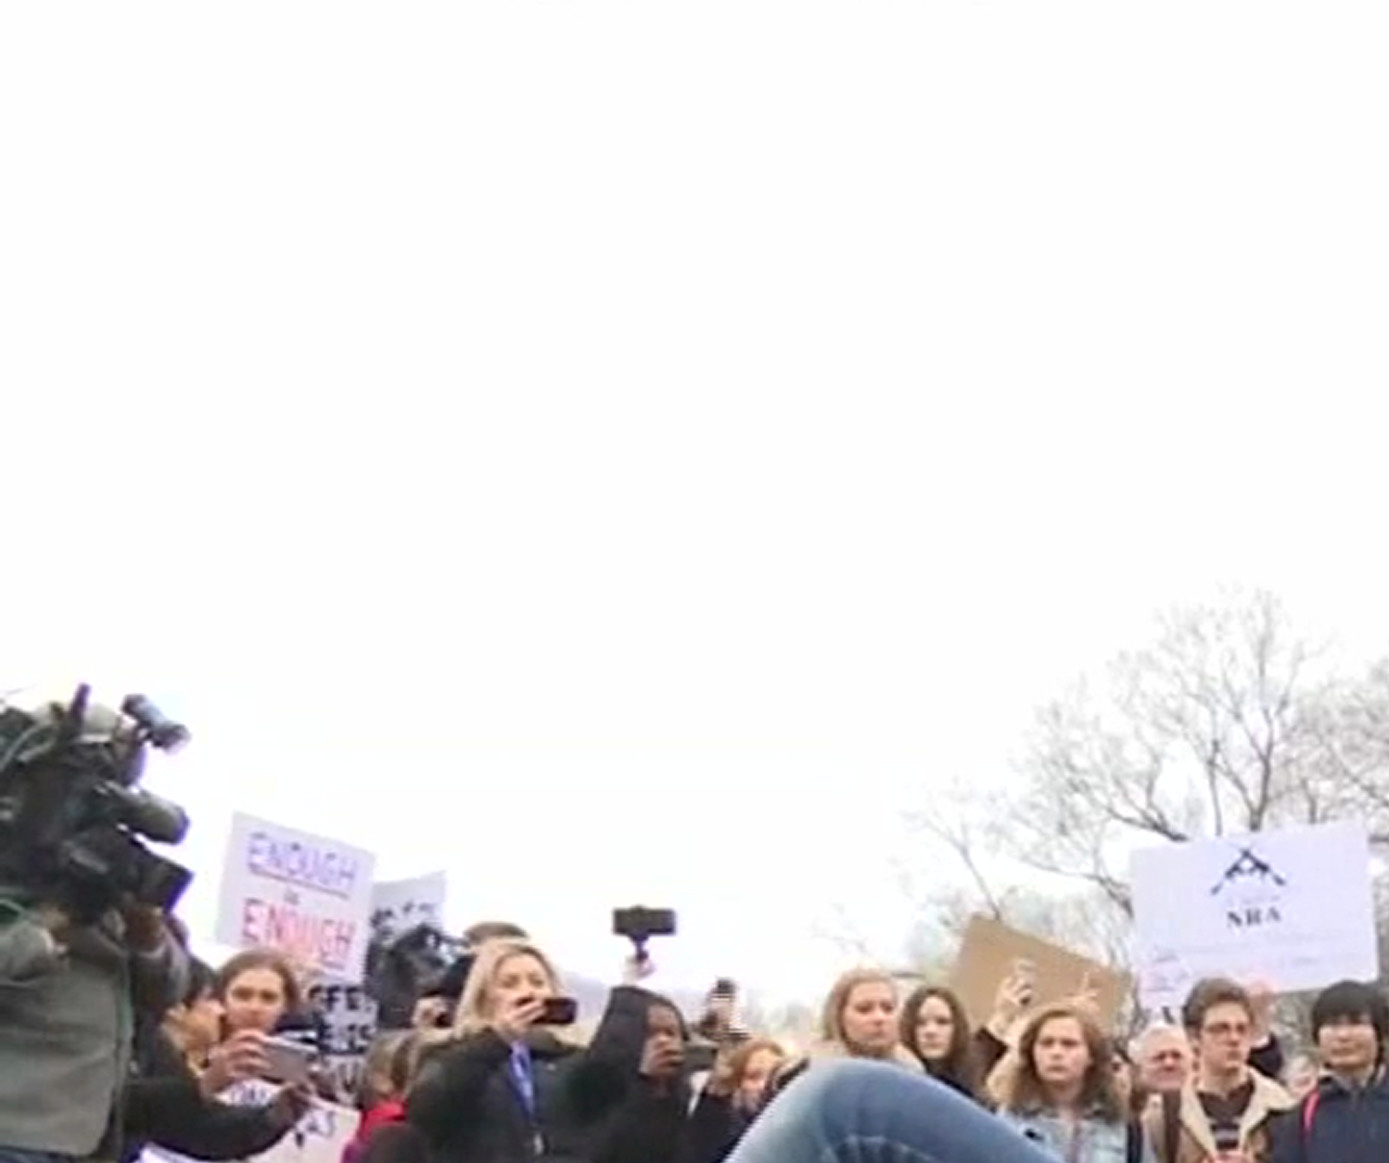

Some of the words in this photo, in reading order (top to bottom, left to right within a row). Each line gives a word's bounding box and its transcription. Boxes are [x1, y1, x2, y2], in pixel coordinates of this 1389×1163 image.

[246, 830, 358, 884] ENOUGH
[243, 897, 356, 954] ENOUGH
[1226, 905, 1281, 928] NRA
